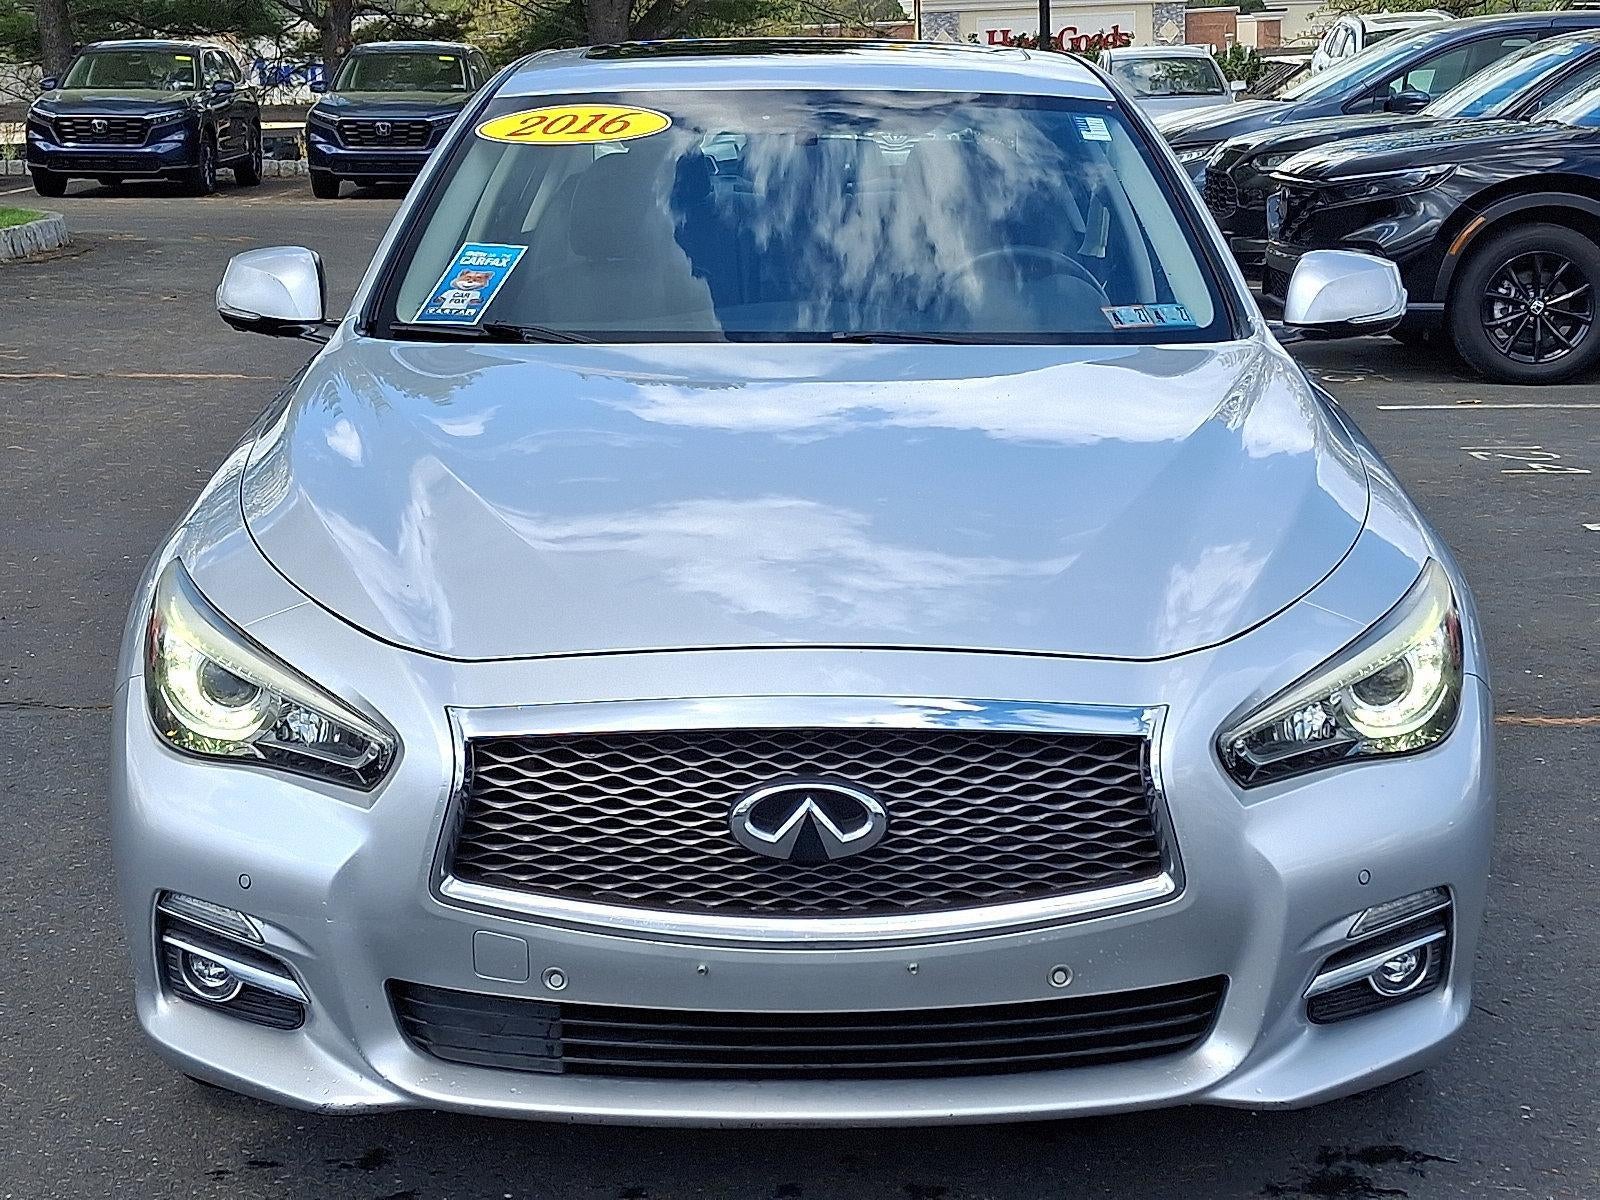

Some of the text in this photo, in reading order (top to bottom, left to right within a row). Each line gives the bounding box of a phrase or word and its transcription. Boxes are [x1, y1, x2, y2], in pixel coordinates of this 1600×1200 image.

[505, 112, 642, 137] 2016
[460, 256, 511, 268] CARFAX
[452, 291, 470, 299] CAR
